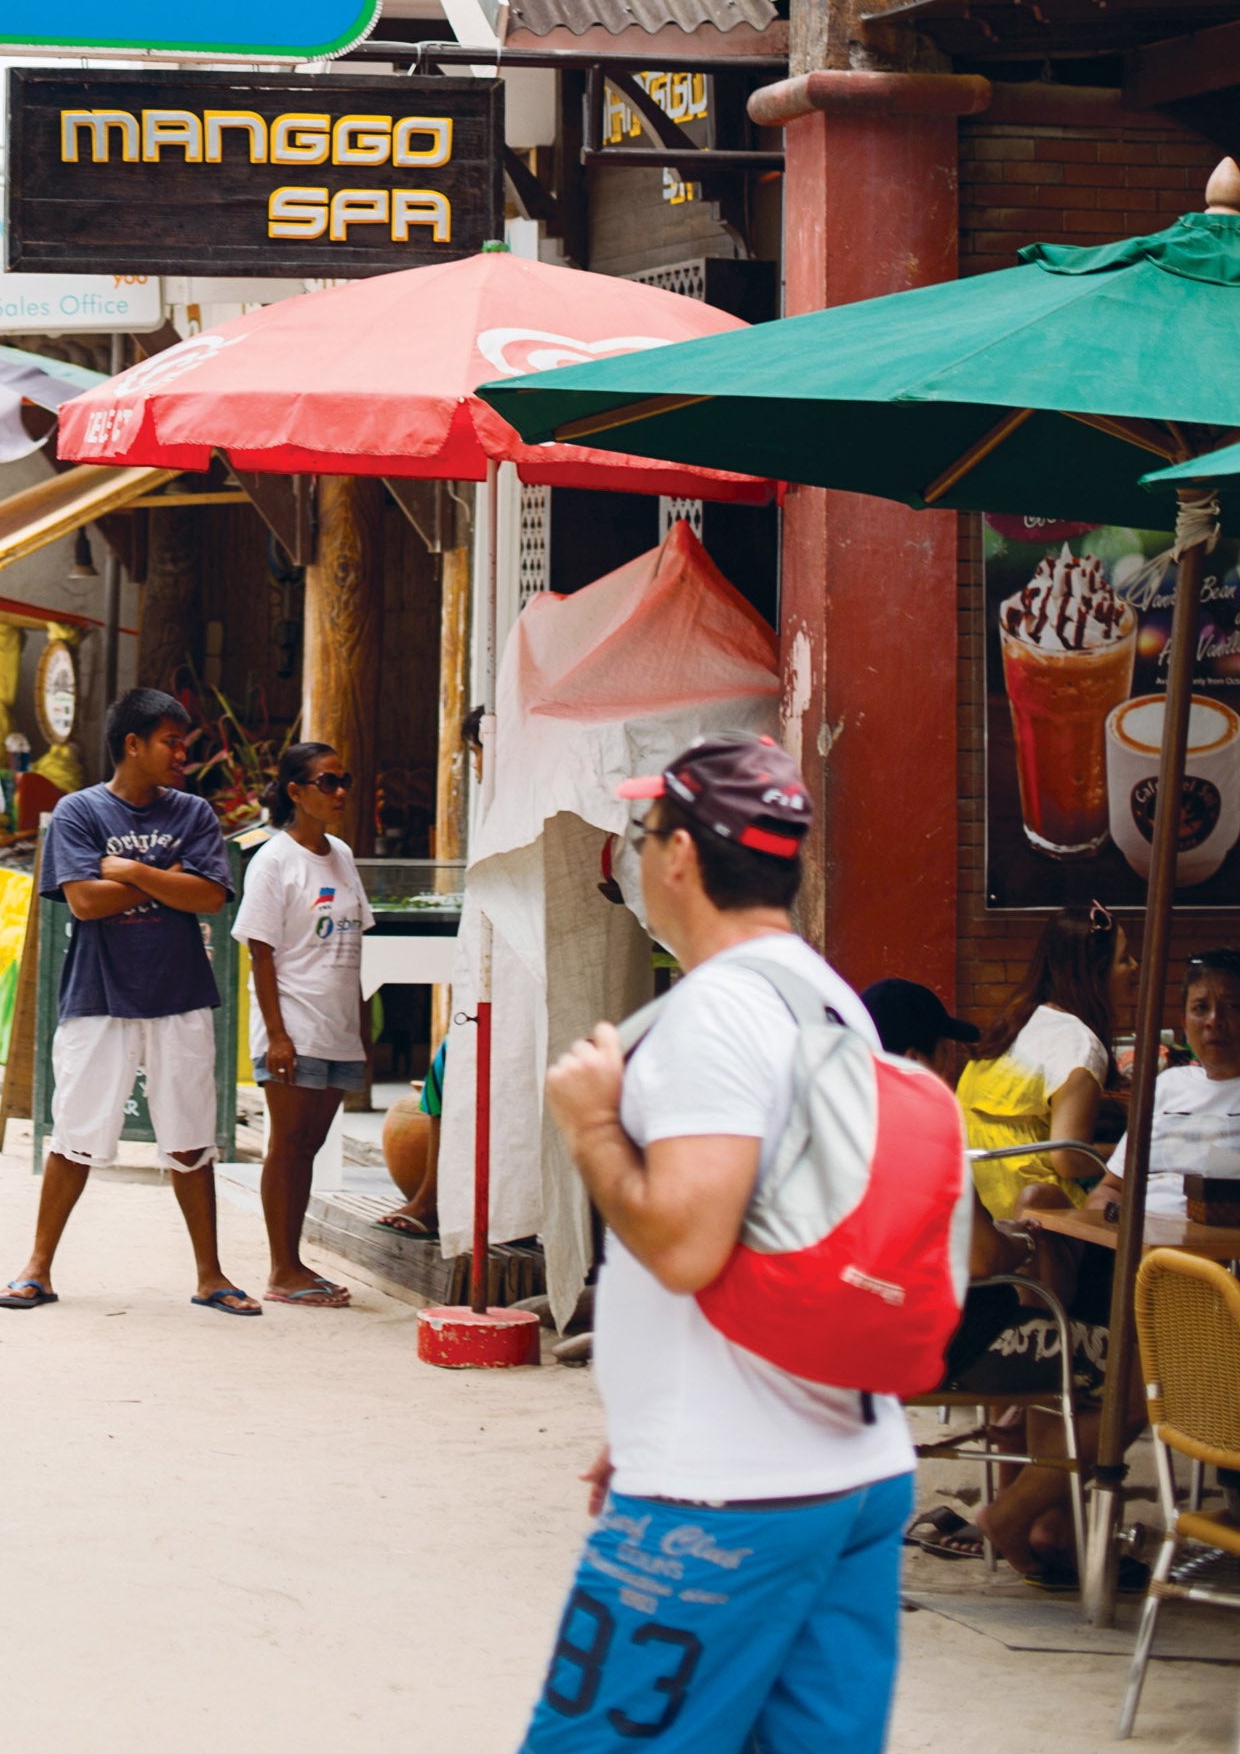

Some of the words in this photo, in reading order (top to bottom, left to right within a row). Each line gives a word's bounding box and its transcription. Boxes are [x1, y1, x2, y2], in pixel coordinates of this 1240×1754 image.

[61, 109, 454, 167] MANGGO
[268, 186, 452, 243] SPA
[60, 294, 129, 315] Office
